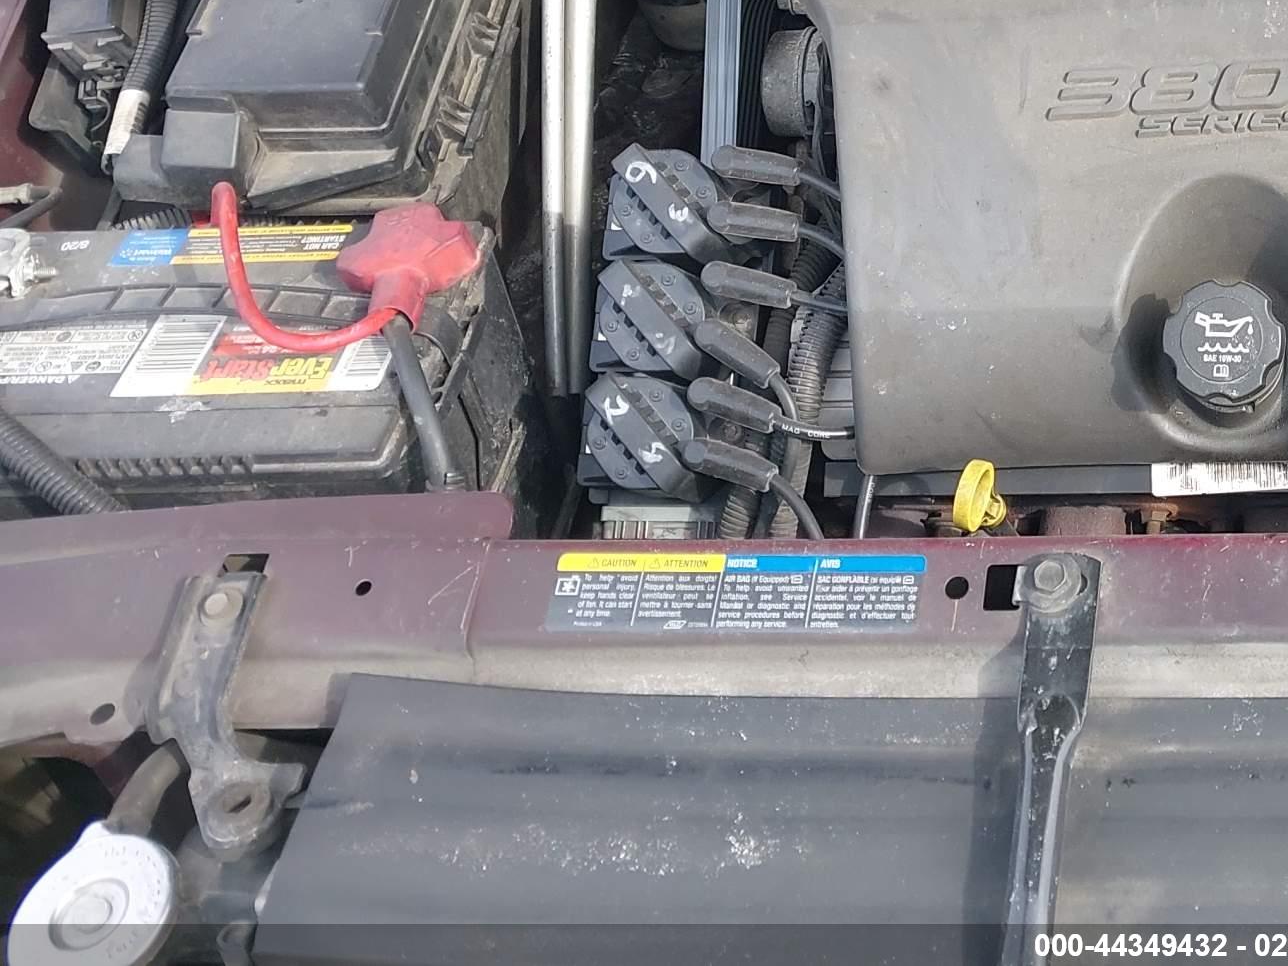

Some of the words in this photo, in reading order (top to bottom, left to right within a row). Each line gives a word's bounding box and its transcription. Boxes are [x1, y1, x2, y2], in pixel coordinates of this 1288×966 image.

[301, 235, 346, 243] STARTING?
[60, 240, 90, 251] 8/20
[303, 242, 321, 251] NOT
[322, 242, 340, 250] CAR
[1203, 353, 1217, 362] SAE
[200, 356, 334, 383] EverStart
[601, 559, 637, 567] CAUTION
[664, 559, 708, 568] ATTENTION
[727, 559, 758, 568] NOTICE
[820, 559, 841, 568] AVIS
[584, 573, 592, 581] To
[599, 574, 615, 583] help
